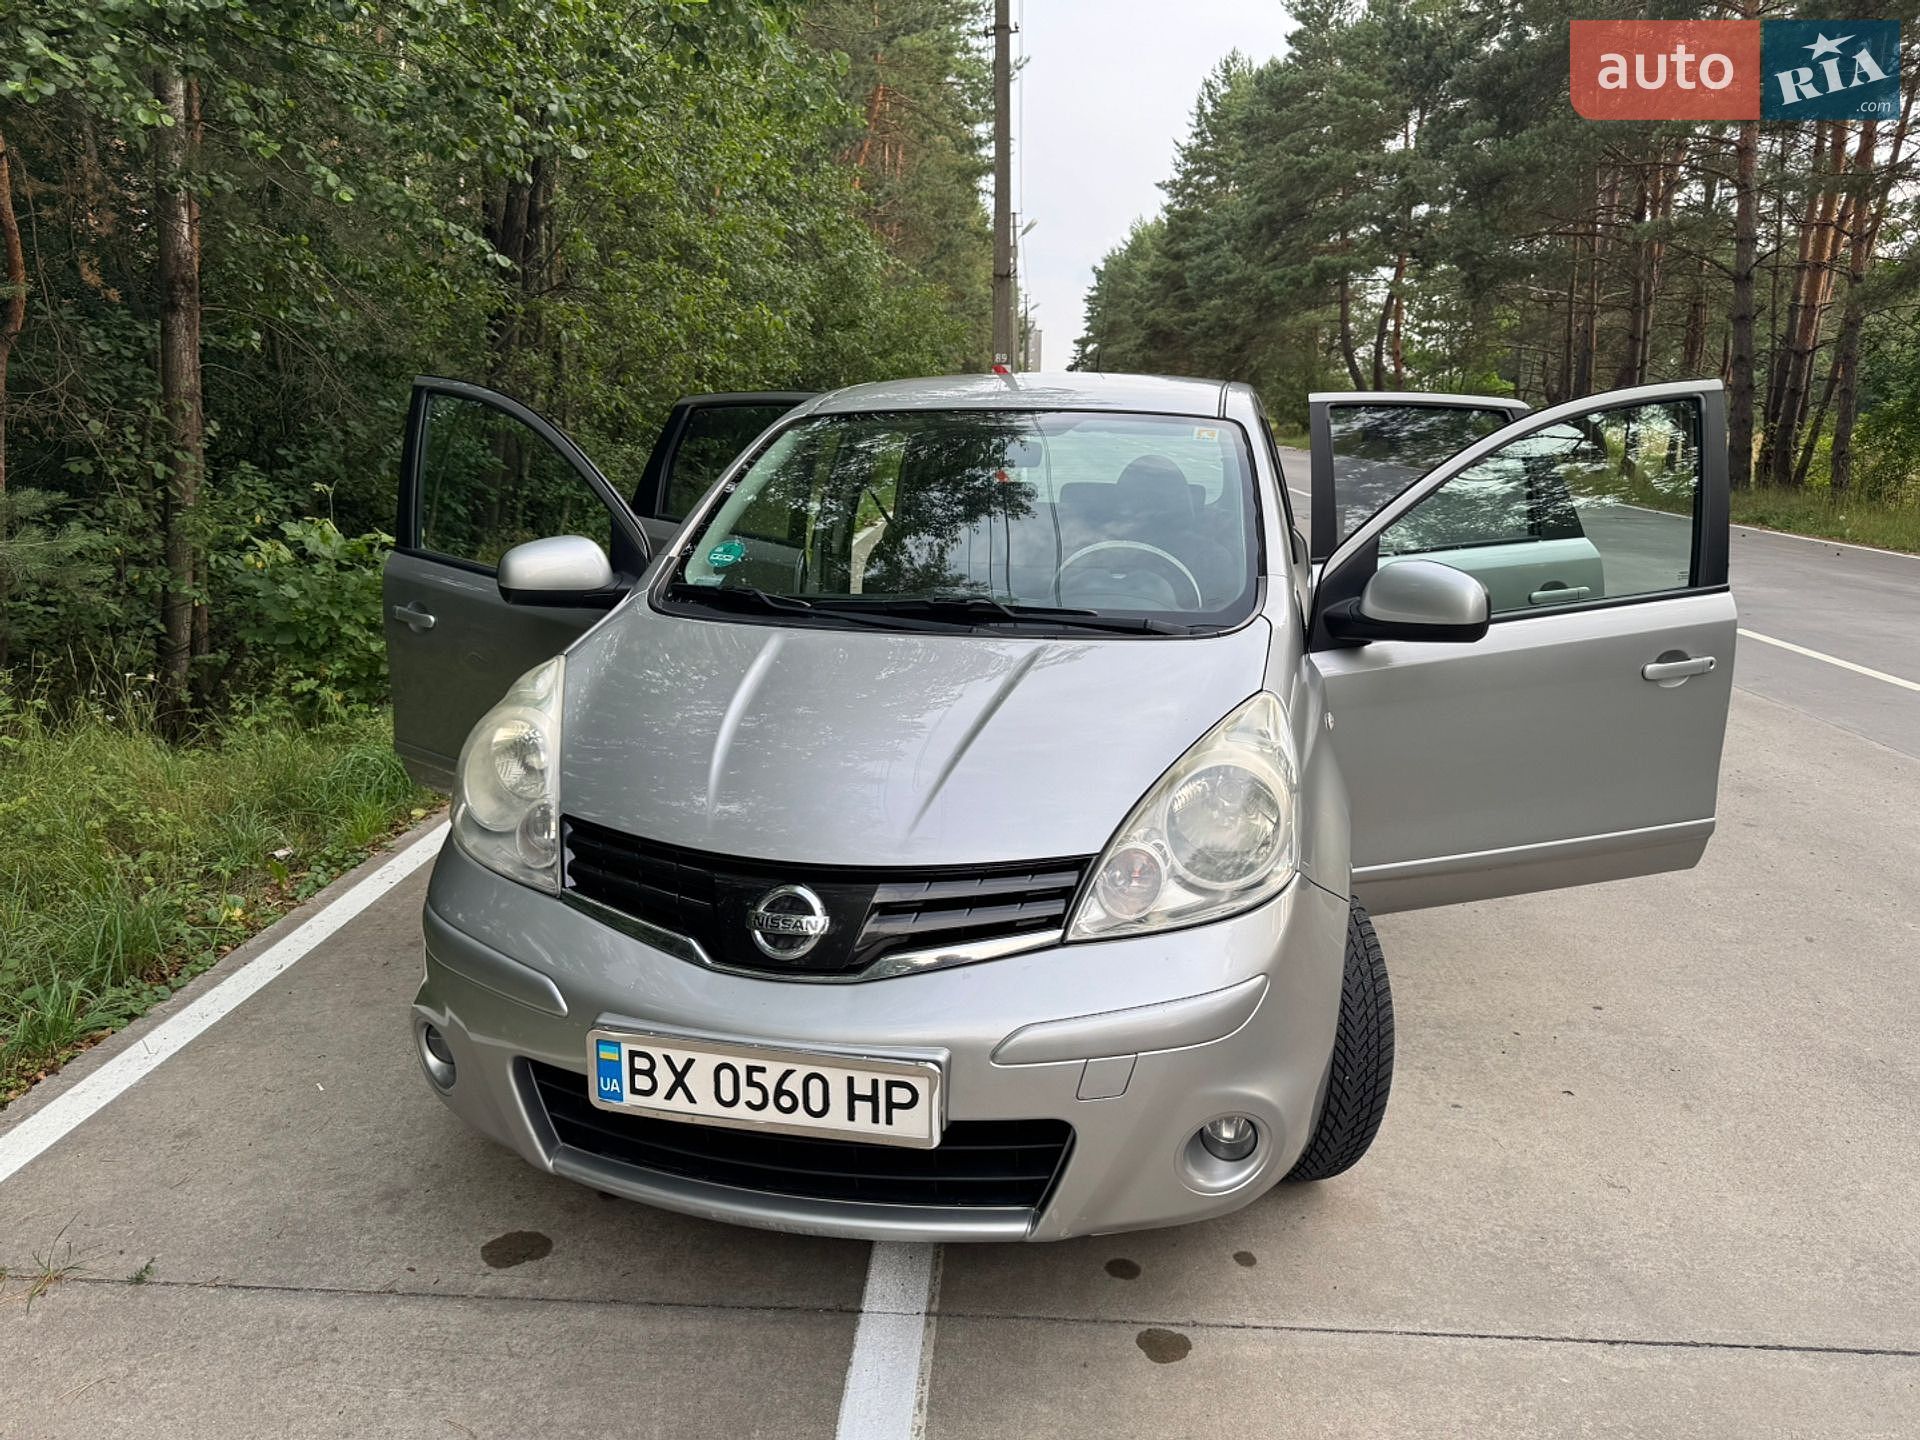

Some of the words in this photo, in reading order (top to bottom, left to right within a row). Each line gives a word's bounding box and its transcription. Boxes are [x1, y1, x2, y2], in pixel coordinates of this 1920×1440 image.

[755, 913, 819, 932] NISSAN
[600, 1077, 621, 1094] UA
[628, 1049, 698, 1105] BX
[713, 1062, 831, 1119] 0560
[846, 1075, 920, 1126] HP
